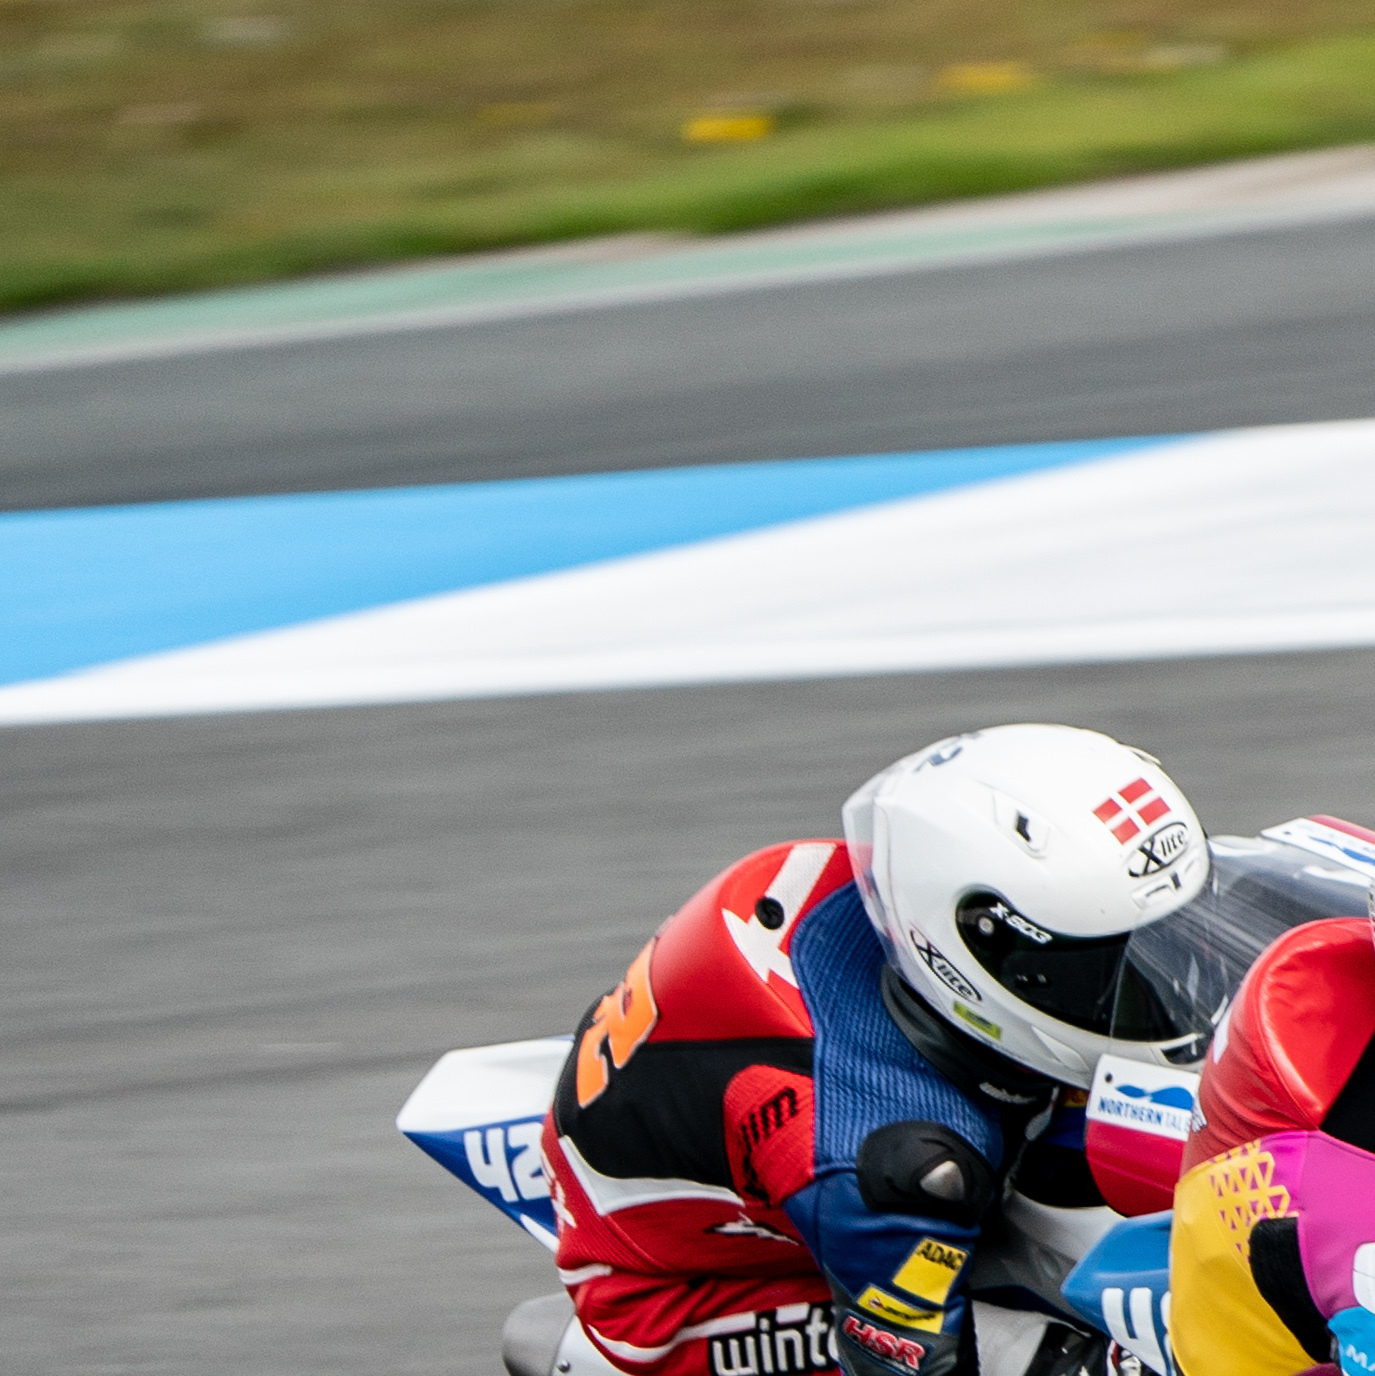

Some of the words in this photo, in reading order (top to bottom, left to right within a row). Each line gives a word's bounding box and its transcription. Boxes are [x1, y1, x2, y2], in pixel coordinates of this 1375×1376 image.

[1099, 1095, 1163, 1125] NORTHERN
[921, 1241, 965, 1271] ADAC
[843, 1314, 926, 1371] HSR
